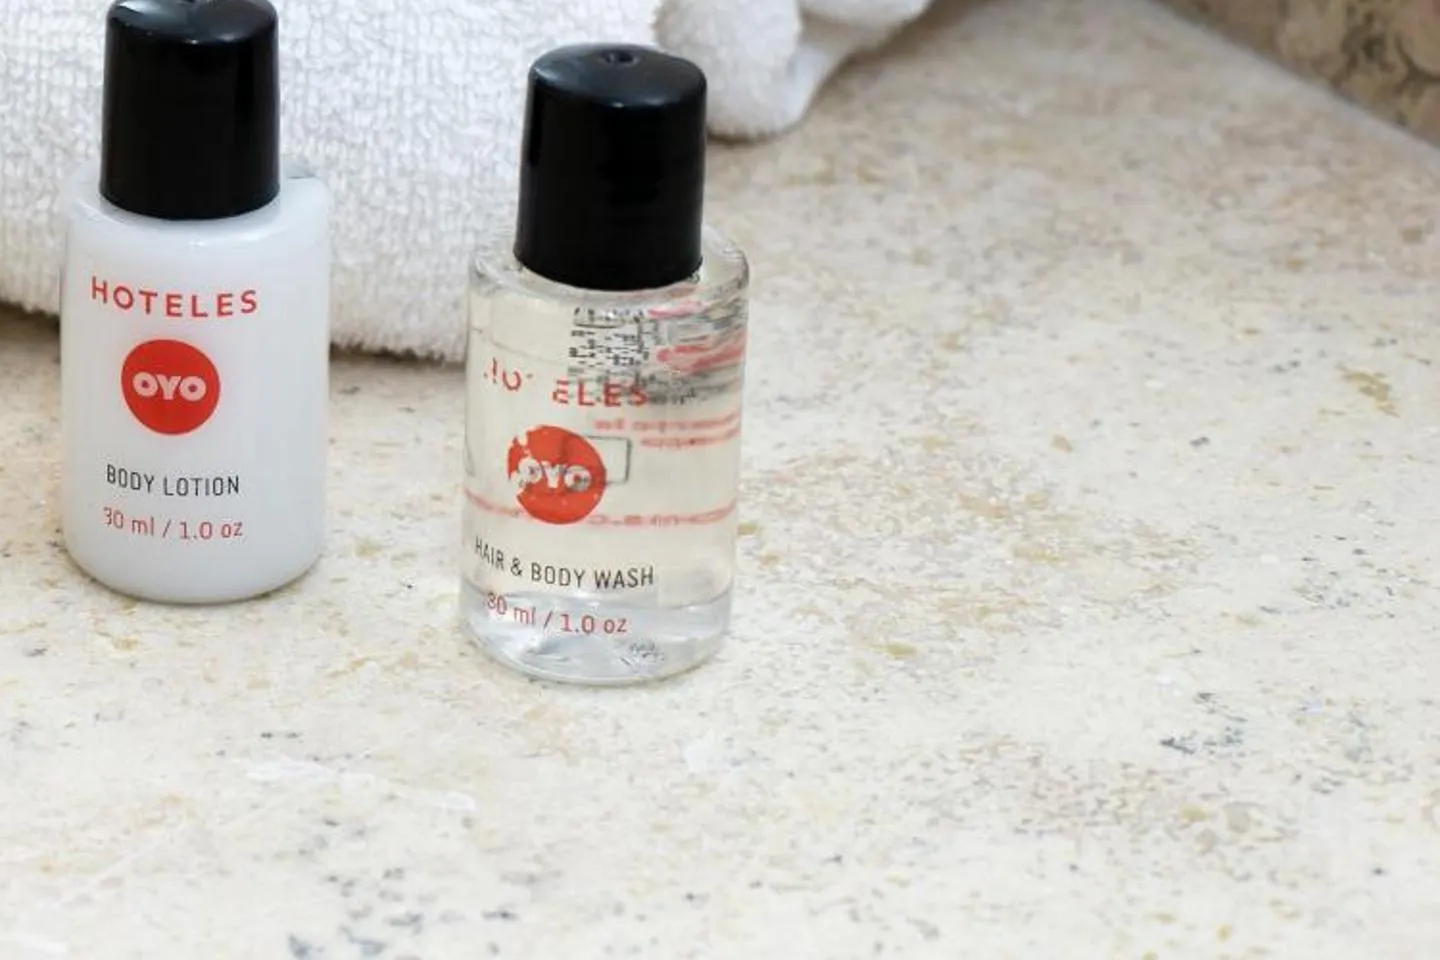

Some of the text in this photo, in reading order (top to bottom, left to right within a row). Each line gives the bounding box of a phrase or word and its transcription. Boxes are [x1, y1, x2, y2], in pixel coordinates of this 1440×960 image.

[90, 276, 259, 318] HOTELES
[131, 371, 208, 403] OYO
[106, 464, 240, 497] BODY LOTION
[103, 506, 124, 530] 30
[131, 516, 155, 537] ml
[180, 521, 213, 540] 1.0
[221, 522, 244, 539] oz
[474, 535, 654, 589] HAIR & BODY WASH
[487, 591, 508, 616] 30
[513, 606, 537, 626] ml
[560, 613, 596, 634] 1.0
[603, 617, 628, 634] oz
